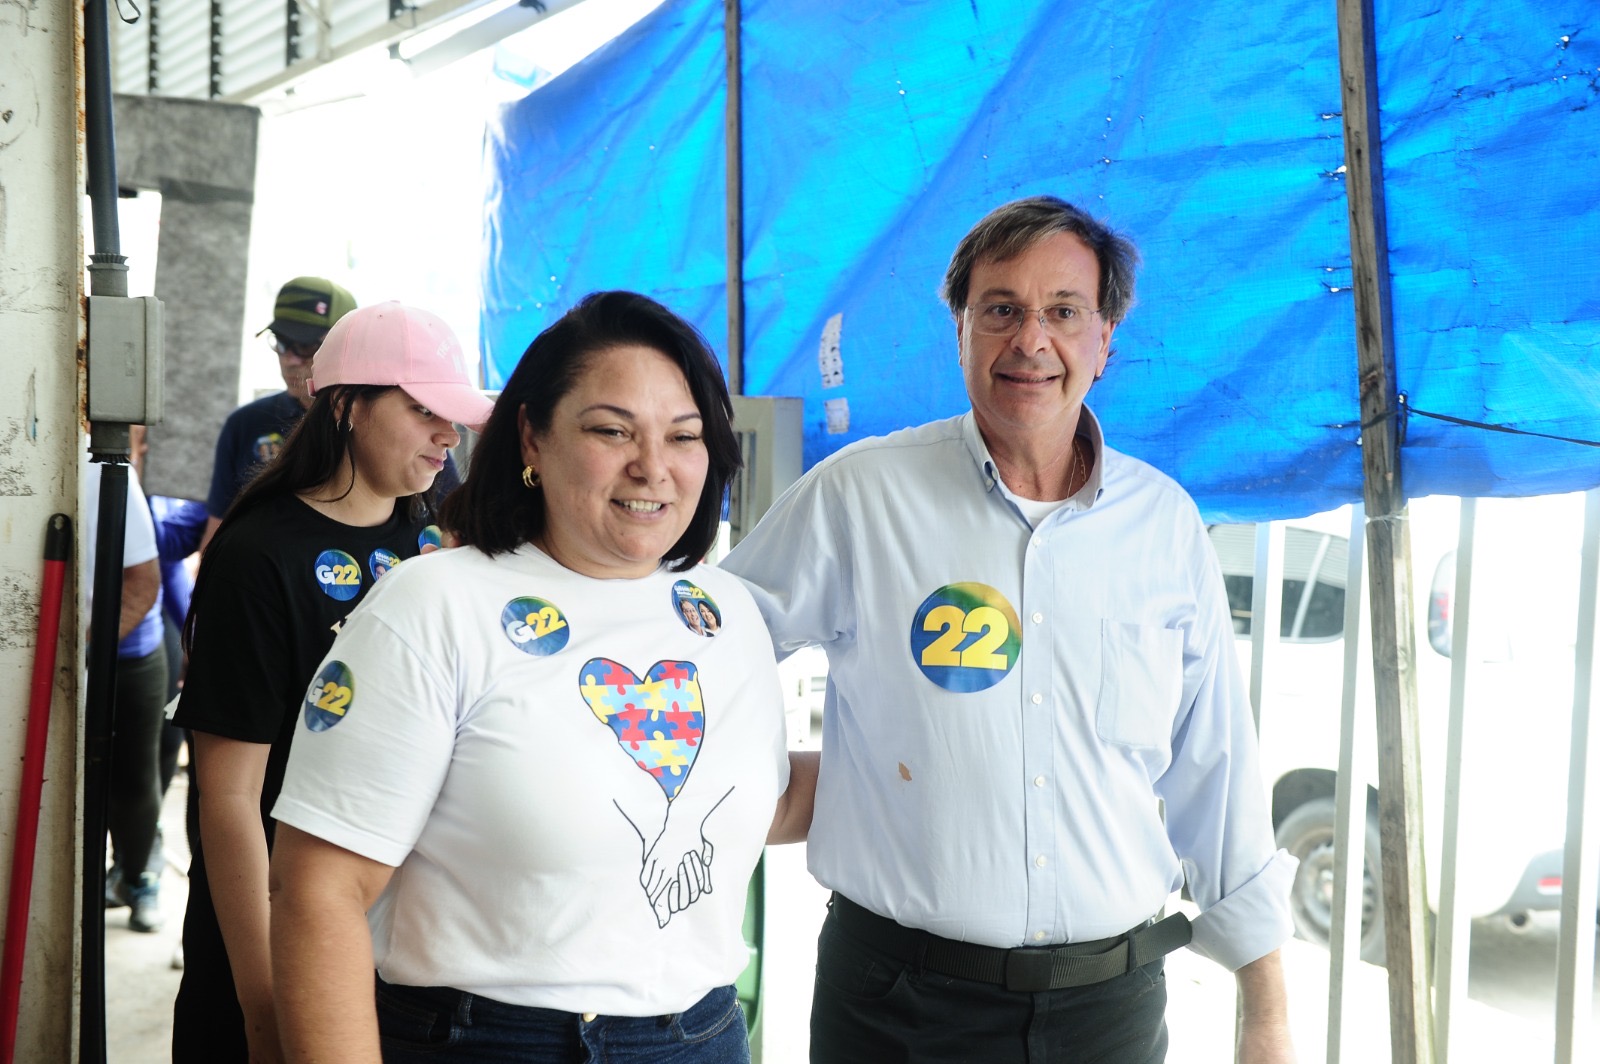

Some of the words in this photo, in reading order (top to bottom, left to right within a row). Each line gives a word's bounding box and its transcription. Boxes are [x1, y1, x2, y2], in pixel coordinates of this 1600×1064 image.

[316, 564, 360, 585] G22
[690, 587, 705, 598] 22
[506, 606, 567, 643] G22
[921, 605, 1009, 670] 22
[308, 677, 352, 717] G22
